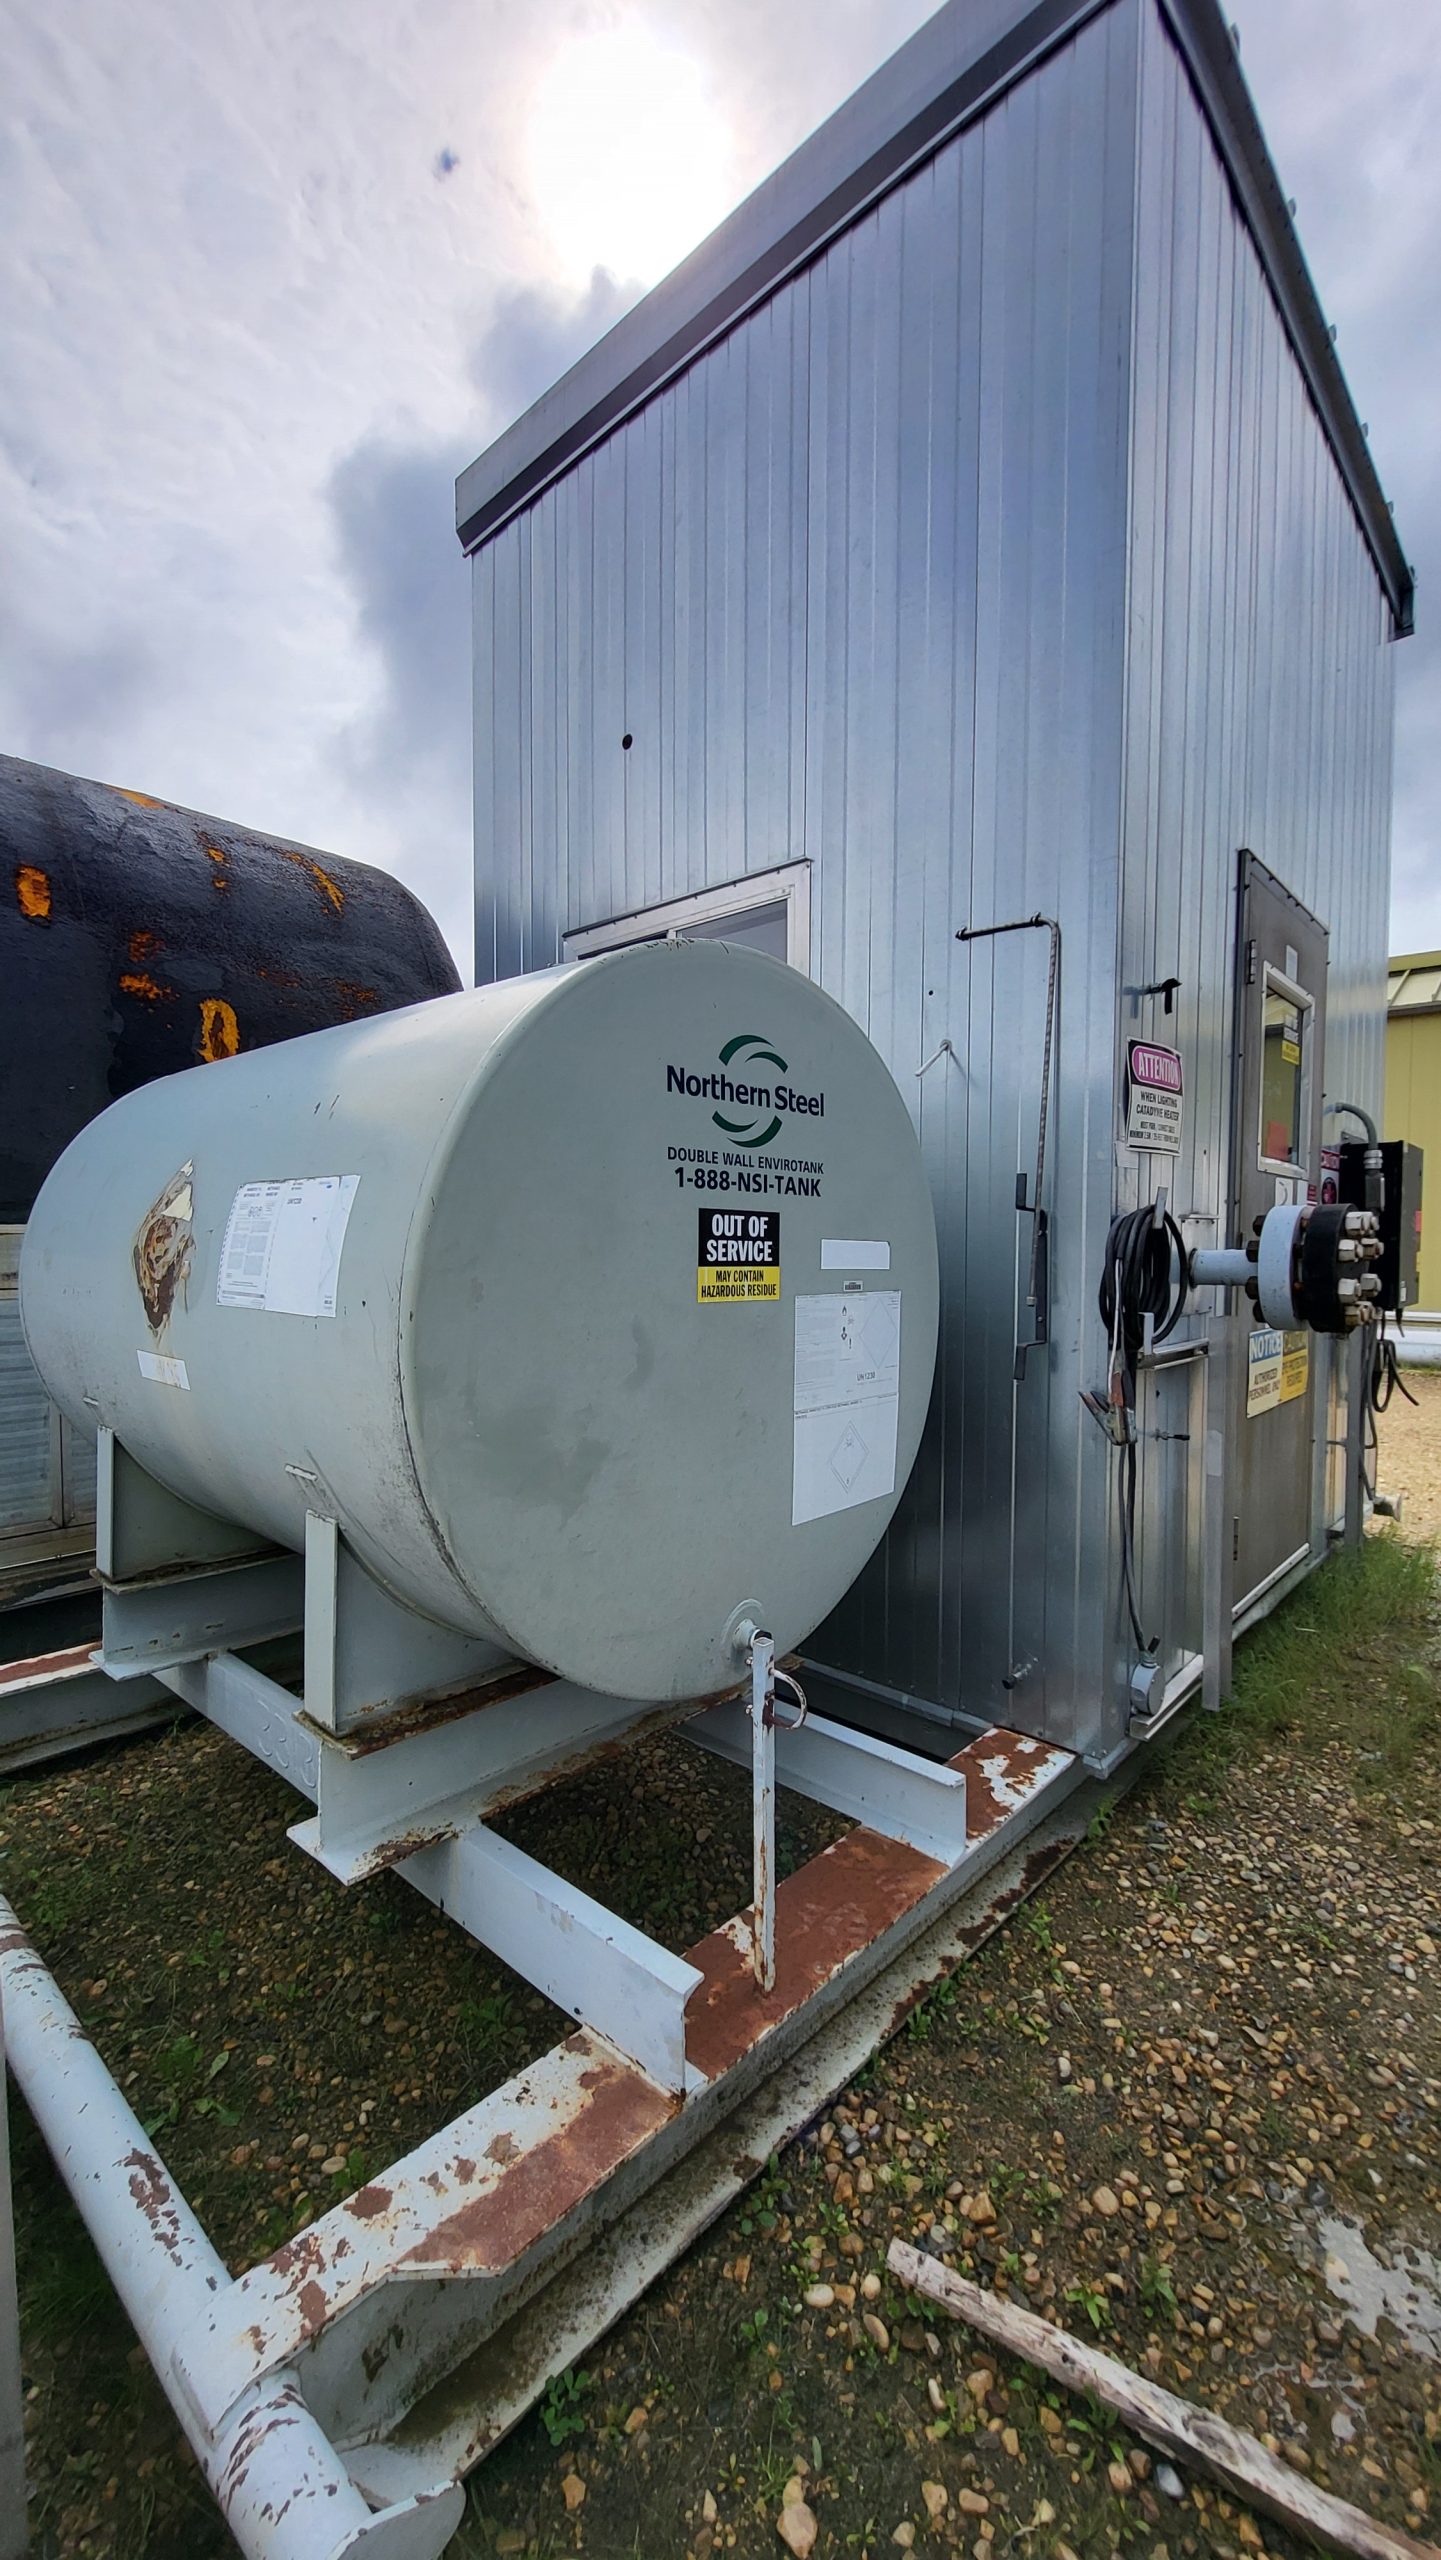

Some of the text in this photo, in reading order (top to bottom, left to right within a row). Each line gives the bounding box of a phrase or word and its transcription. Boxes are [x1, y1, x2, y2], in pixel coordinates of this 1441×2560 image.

[1138, 1052, 1179, 1085] ATTENTION
[667, 1065, 824, 1117] Northern Steel
[1141, 1091, 1156, 1103] WHEN
[667, 1147, 824, 1174] DOUBLE WALL ENVIROTANK
[674, 1167, 821, 1197] 1-888-NSI-TANK
[712, 1214, 769, 1237] OUT OF
[706, 1240, 773, 1262] SERVICE
[715, 1270, 764, 1282] MAY CONTAIN
[701, 1284, 776, 1297] HAZARDOUS RESIDUE
[1250, 1332, 1281, 1359] NOTICE
